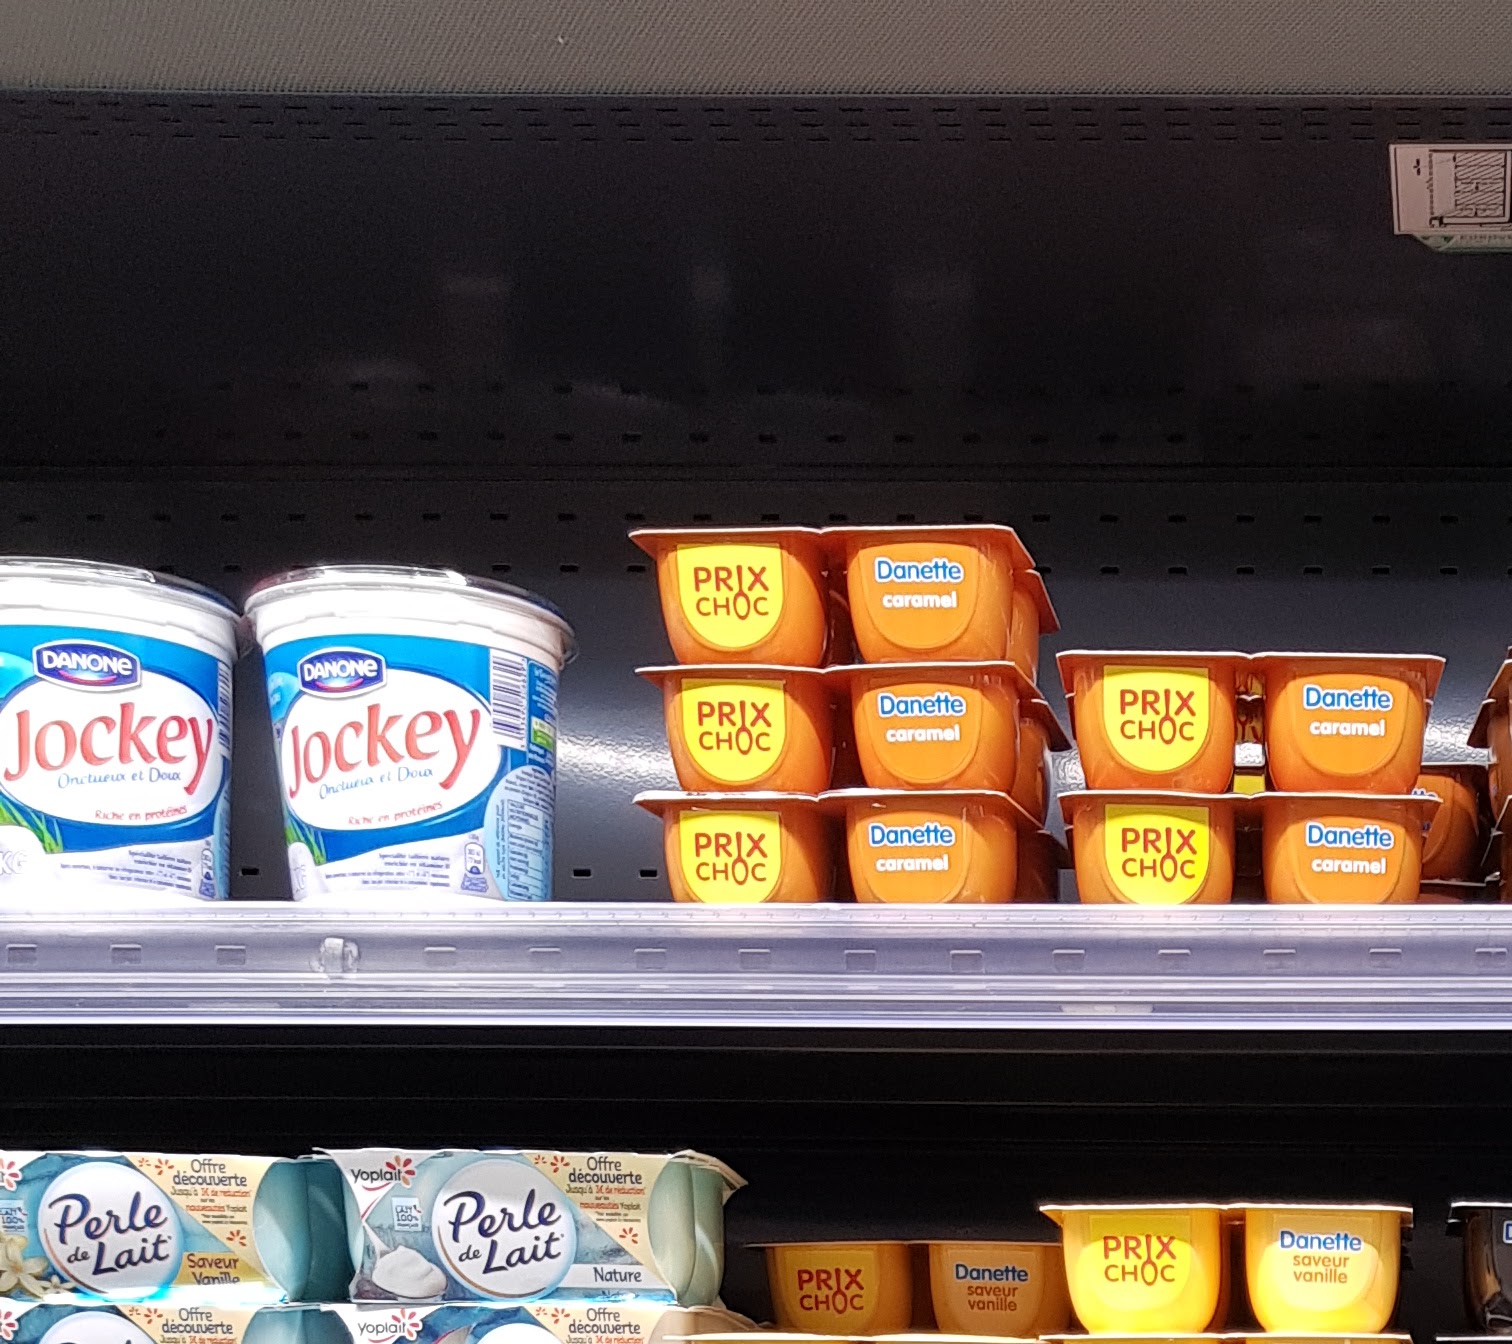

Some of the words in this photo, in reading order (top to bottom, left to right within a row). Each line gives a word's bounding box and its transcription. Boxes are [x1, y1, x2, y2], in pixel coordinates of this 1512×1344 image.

[695, 566, 769, 594] PRIX
[876, 559, 963, 582] Danette
[696, 591, 769, 620] CHOC
[882, 591, 957, 609] caramel
[42, 649, 132, 676] DANONE
[304, 657, 377, 682] DANONE
[4, 703, 214, 795] Jockey
[287, 703, 481, 799] Jockey
[58, 772, 125, 788] Onctueux
[132, 772, 144, 781] et
[150, 767, 181, 782] Doux
[128, 812, 141, 820] en
[190, 1159, 226, 1174] Offre
[173, 1172, 247, 1187] découverte
[54, 1192, 168, 1245] Perle
[444, 1189, 562, 1242] Perle
[1280, 1231, 1362, 1251] Danette
[67, 1247, 90, 1263] de
[92, 1235, 170, 1275] Lait
[187, 1254, 239, 1271] Saveur
[459, 1248, 482, 1261] de
[482, 1234, 563, 1274] Lait
[1293, 1255, 1350, 1267] saveur
[593, 1267, 642, 1283] Nature
[797, 1268, 864, 1292] PRIX
[955, 1263, 1028, 1281] Danette
[1293, 1269, 1348, 1284] vanille
[967, 1285, 1018, 1297] saveur
[800, 1294, 864, 1314] CHOC
[968, 1299, 1017, 1311] vanille
